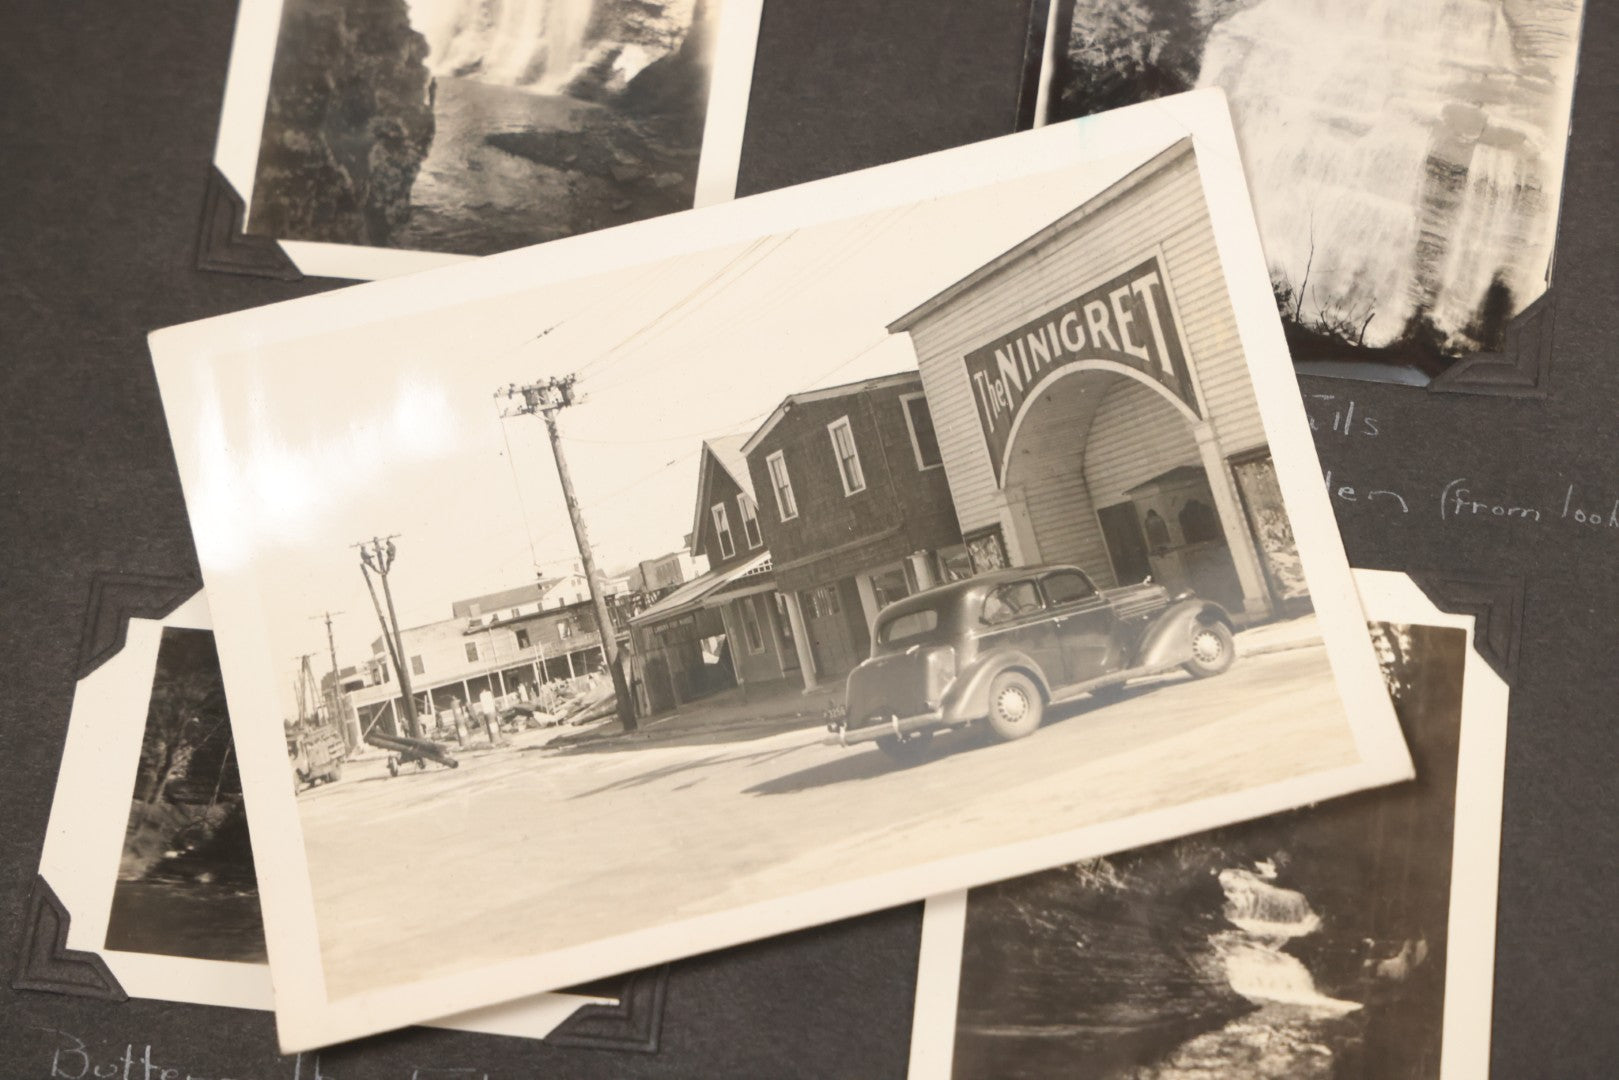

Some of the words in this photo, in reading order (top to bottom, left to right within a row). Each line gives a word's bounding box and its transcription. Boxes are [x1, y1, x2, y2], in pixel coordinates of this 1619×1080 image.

[973, 369, 1007, 434] The
[994, 270, 1176, 412] NINIGRET
[1441, 478, 1540, 521] (from
